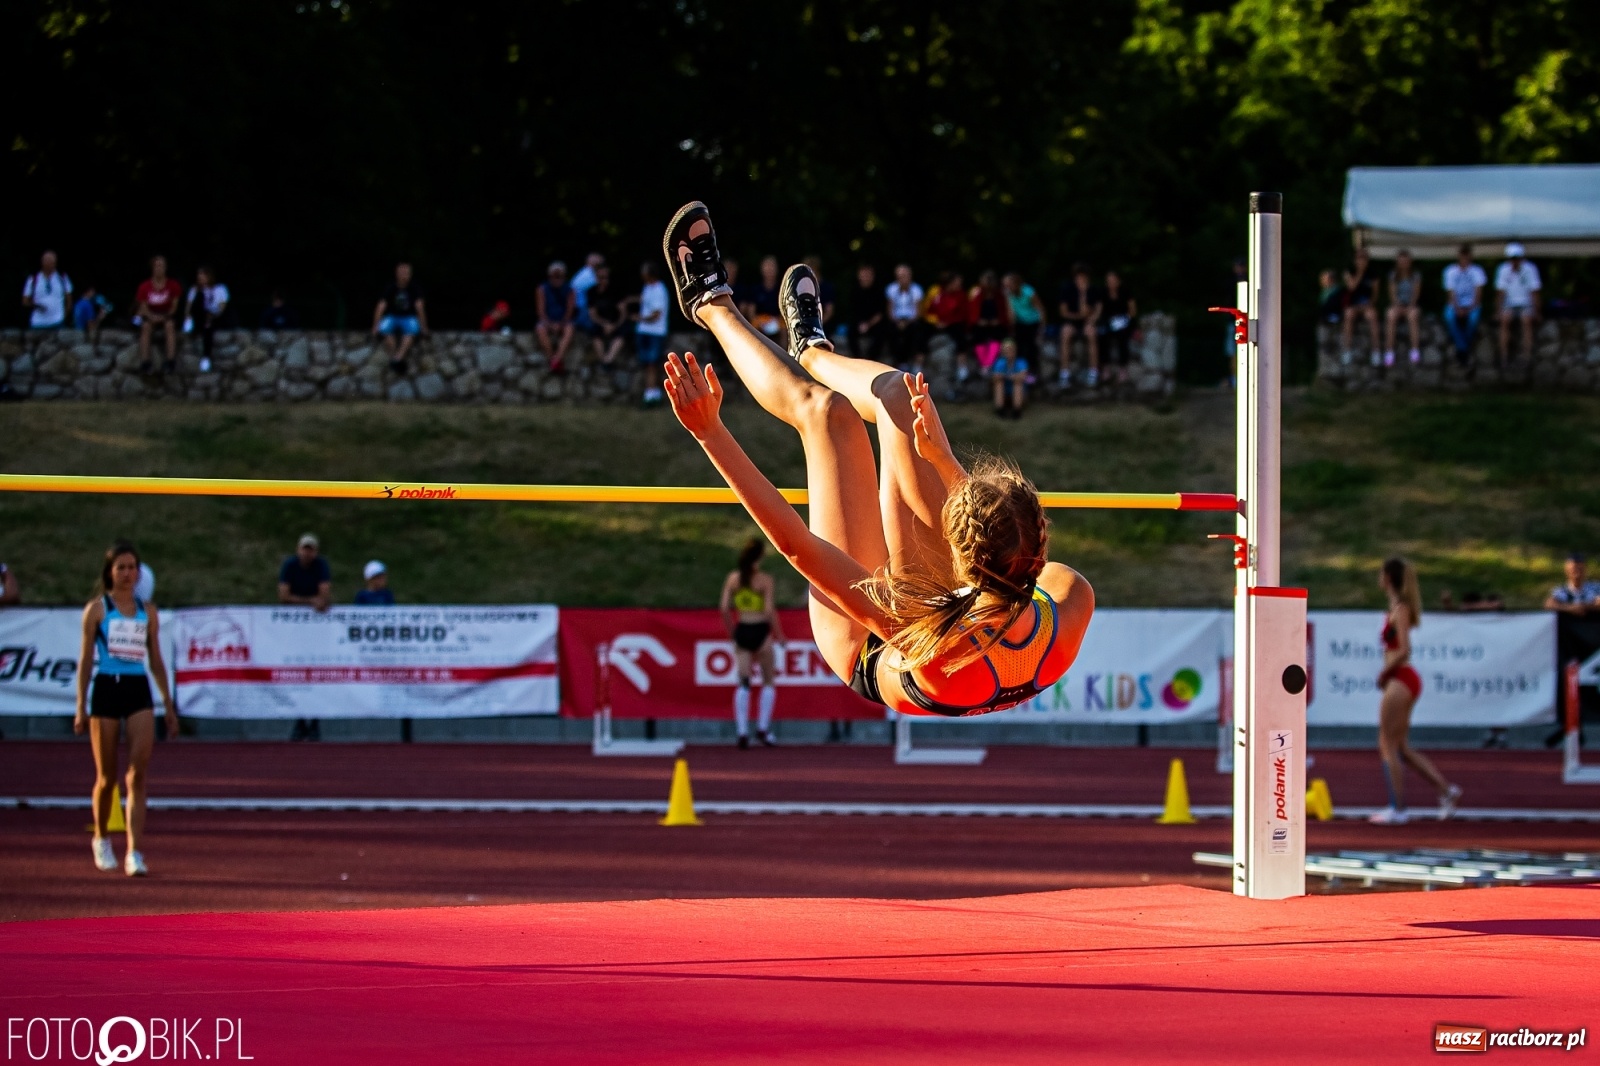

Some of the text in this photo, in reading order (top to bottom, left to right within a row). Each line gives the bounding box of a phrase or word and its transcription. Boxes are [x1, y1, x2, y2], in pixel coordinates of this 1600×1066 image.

[399, 486, 457, 499] polanik
[706, 650, 833, 677] OEN
[1330, 640, 1485, 661] Minirstwo
[1085, 673, 1154, 711] KIDS
[1274, 757, 1288, 821] polanik
